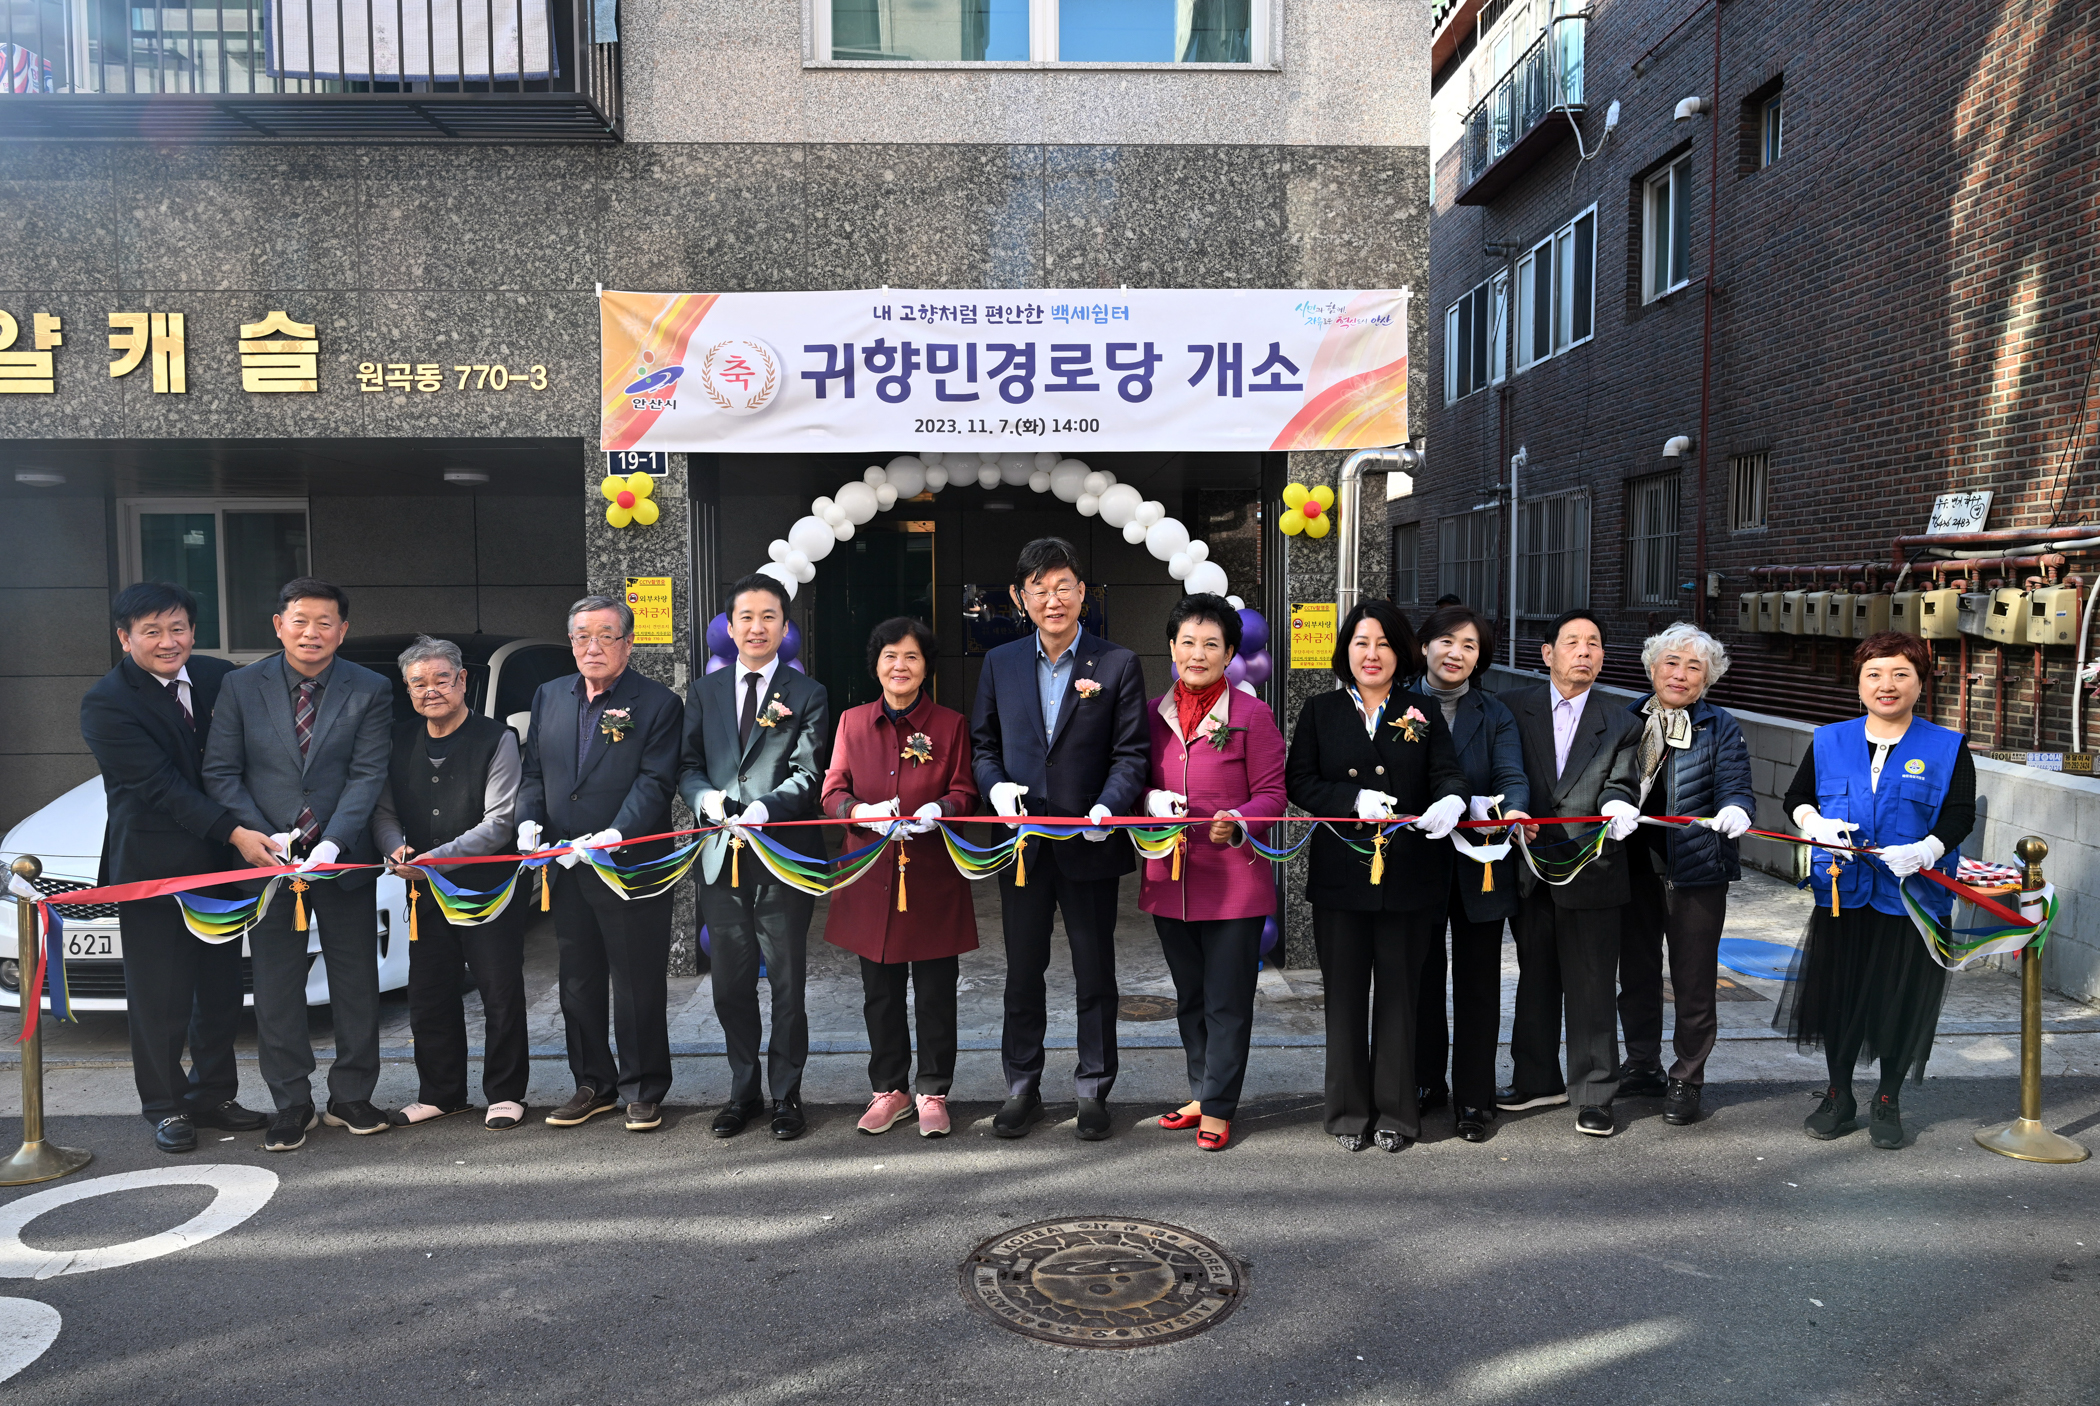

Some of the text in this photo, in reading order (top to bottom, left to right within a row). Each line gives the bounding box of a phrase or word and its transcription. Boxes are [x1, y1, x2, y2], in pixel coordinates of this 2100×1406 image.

[873, 302, 1130, 325] 내 고향처럼 편안한 백세쉼터
[356, 362, 548, 392] 원곡동 770-3
[719, 354, 756, 392] 축
[801, 336, 1304, 405] 귀향민경로당 개소
[631, 397, 677, 410] 안산시
[914, 418, 962, 435] 2023.
[967, 418, 994, 435] 11.
[1052, 418, 1100, 434] 14:00
[618, 451, 657, 469] 19-1
[640, 595, 668, 603] 외부차량
[1304, 621, 1332, 629] 외부차량
[1292, 632, 1334, 644] 주차금지
[1000, 1226, 1060, 1252] KOREA
[1143, 1244, 1227, 1336] KOREA ANSAN
